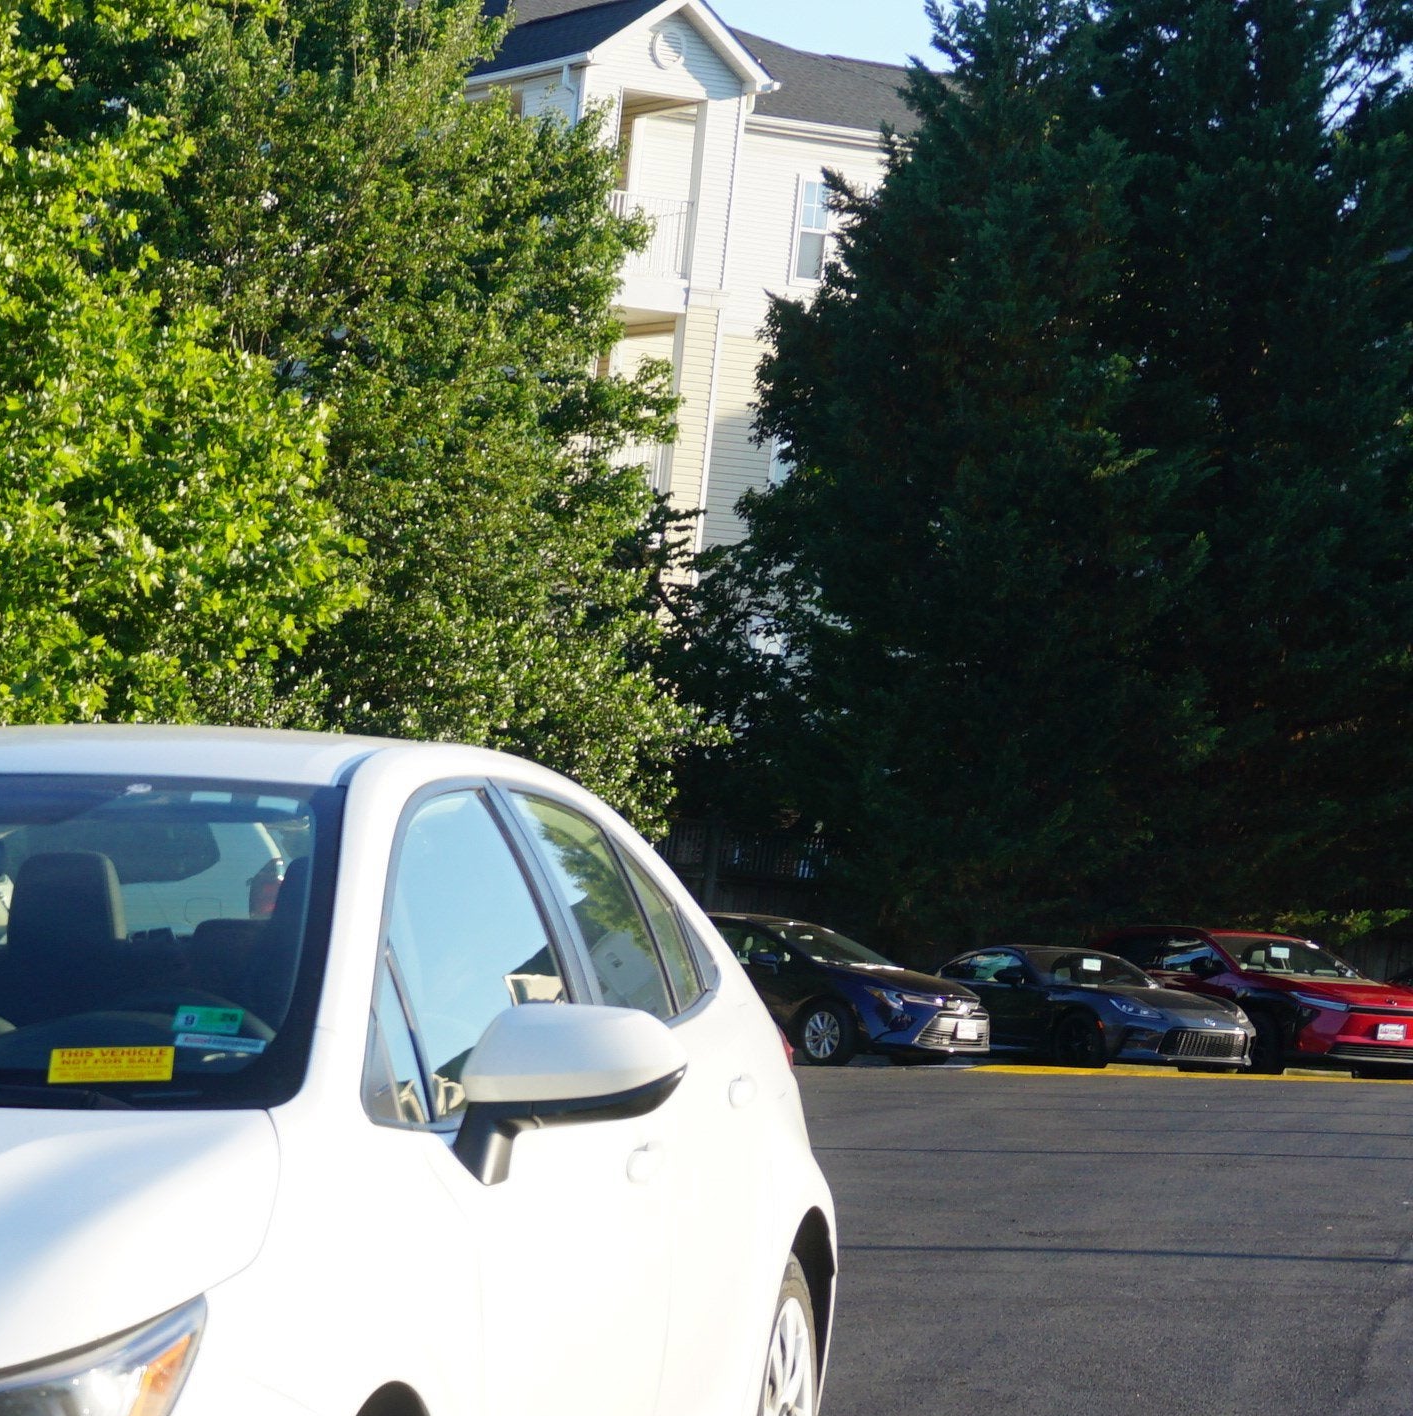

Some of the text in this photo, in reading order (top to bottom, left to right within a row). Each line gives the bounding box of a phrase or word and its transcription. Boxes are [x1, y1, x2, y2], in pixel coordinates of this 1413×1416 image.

[59, 1048, 168, 1058] THIS VEHICLE
[94, 1057, 122, 1065] FOR
[128, 1056, 162, 1064] SALE
